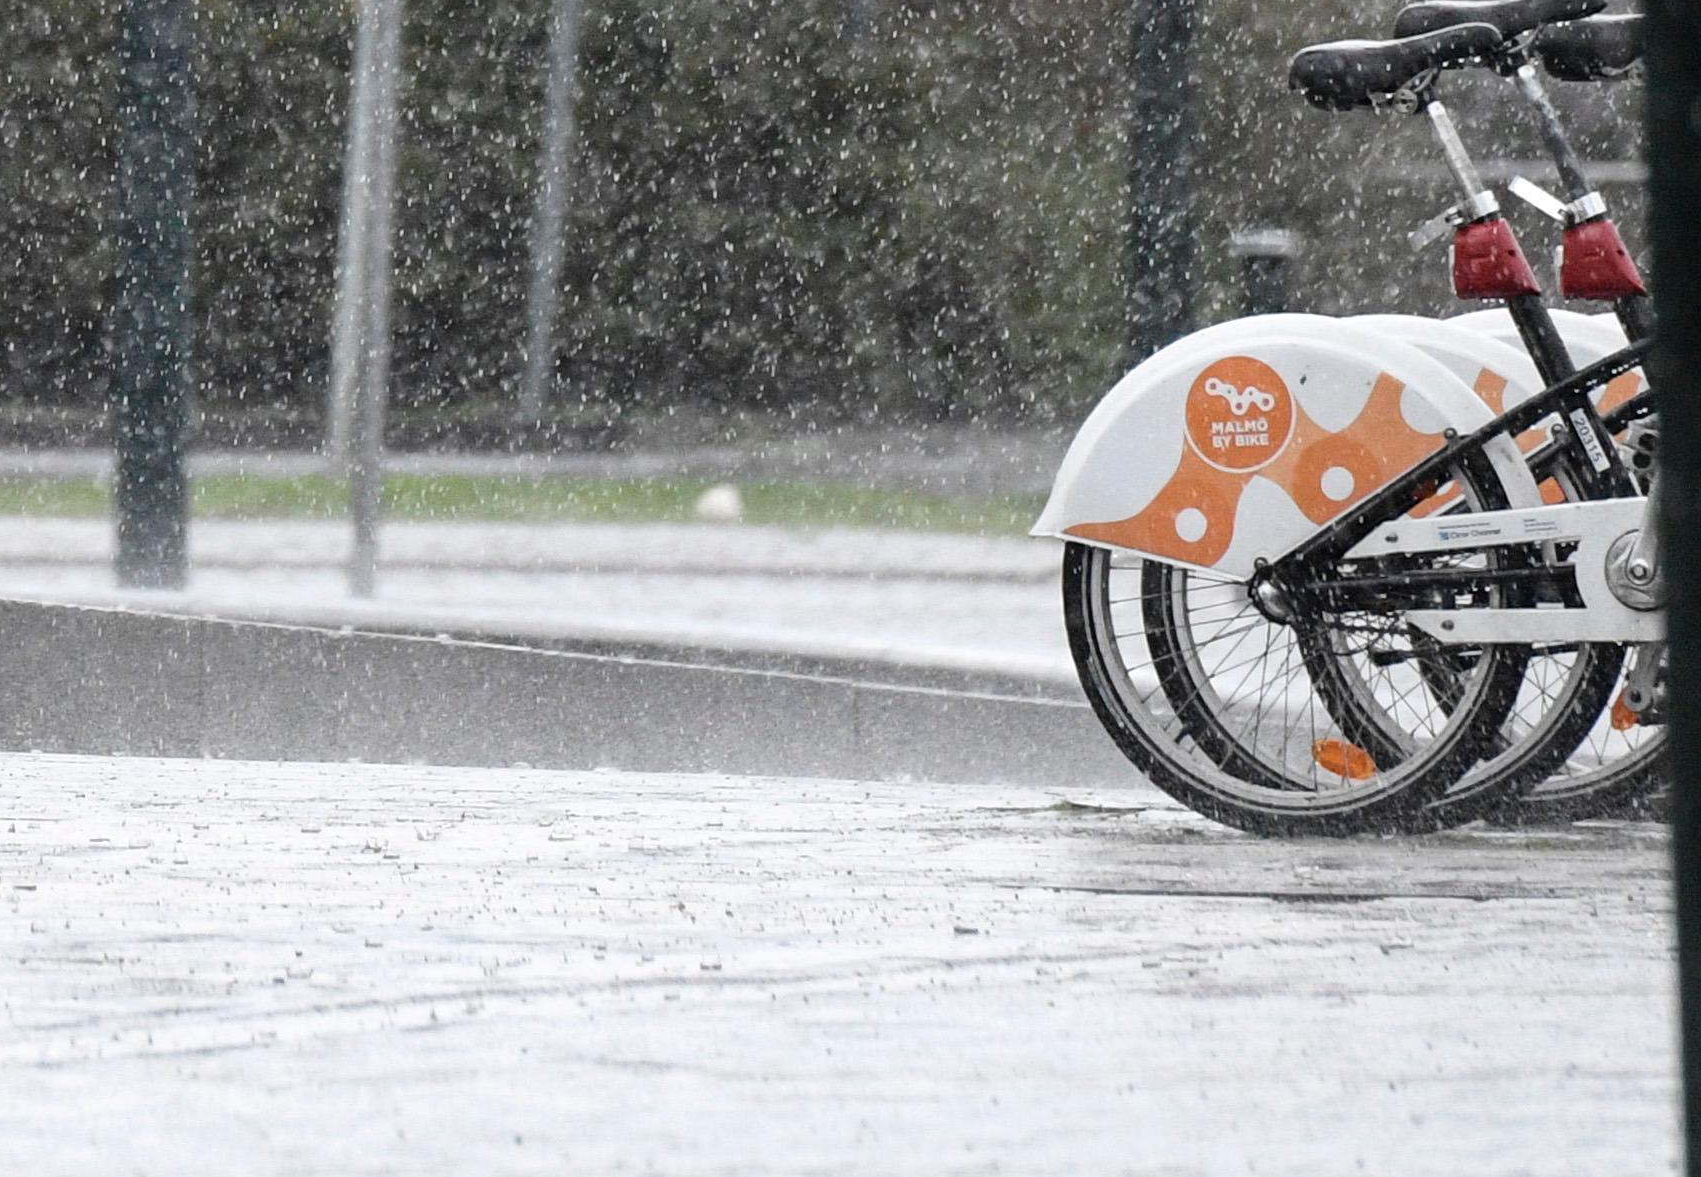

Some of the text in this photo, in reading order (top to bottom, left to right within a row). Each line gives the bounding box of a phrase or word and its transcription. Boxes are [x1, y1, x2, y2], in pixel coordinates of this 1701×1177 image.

[1211, 417, 1269, 434] MALMÖ
[1212, 433, 1269, 448] BY BIKE
[1574, 417, 1604, 463] 20315
